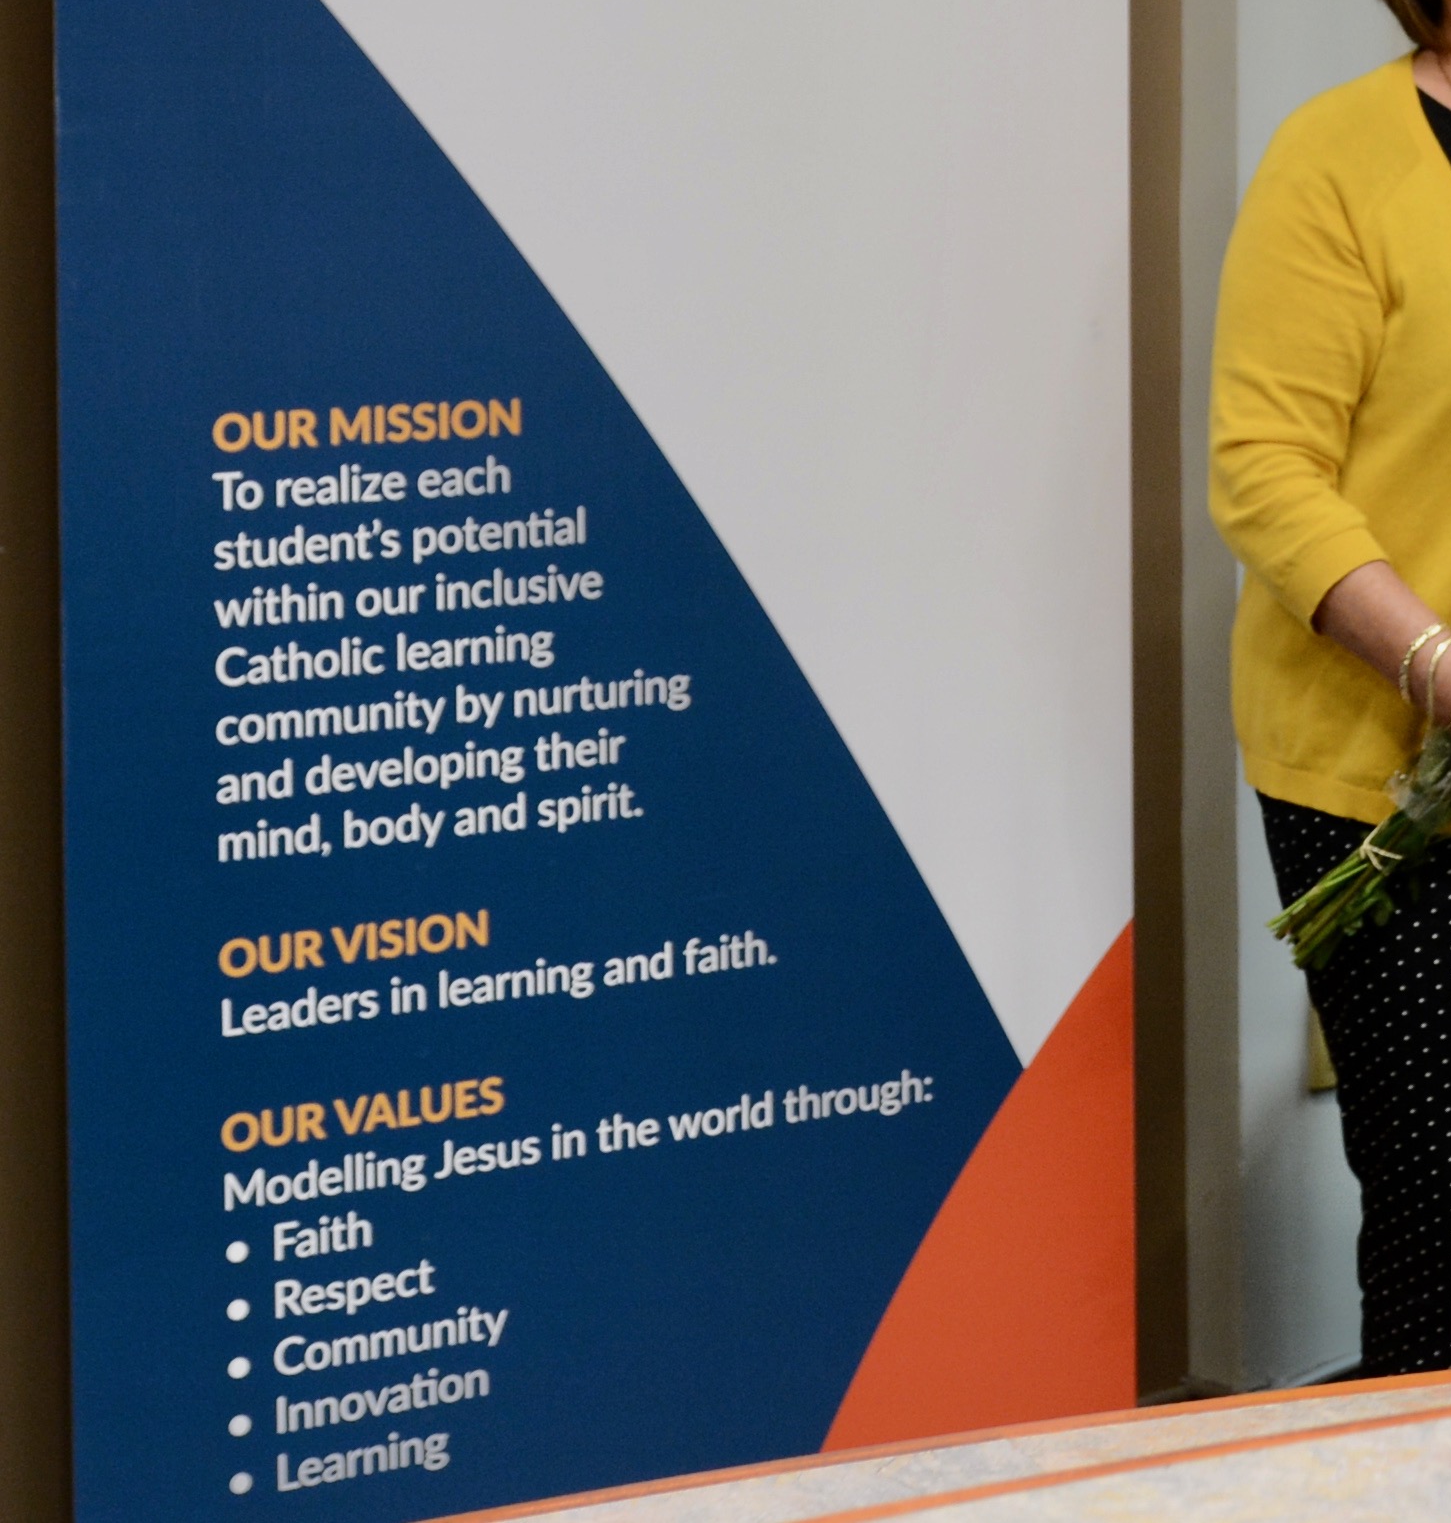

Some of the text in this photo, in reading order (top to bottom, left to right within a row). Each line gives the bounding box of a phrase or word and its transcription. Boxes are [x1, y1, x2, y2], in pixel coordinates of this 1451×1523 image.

[213, 398, 521, 452] OUR MISSION
[212, 455, 510, 511] To realize each
[214, 506, 586, 570] student's potential
[214, 564, 603, 628] within our inclusive
[216, 625, 554, 687] Catholic learning
[216, 669, 691, 745] community by nurturing
[216, 728, 626, 804] and developing their
[219, 783, 643, 862] mind, body and spirit.
[219, 909, 488, 977] OUR VISION
[222, 930, 777, 1037] Leaders in learning and faith.
[221, 1076, 504, 1152] OUR VALUES
[224, 1070, 933, 1211] Modelling Jesus in the world through:
[274, 1211, 372, 1261] Faith
[275, 1260, 435, 1319] Respect
[274, 1307, 508, 1377] Community
[276, 1368, 489, 1434] Innovation
[277, 1432, 450, 1491] Learning
